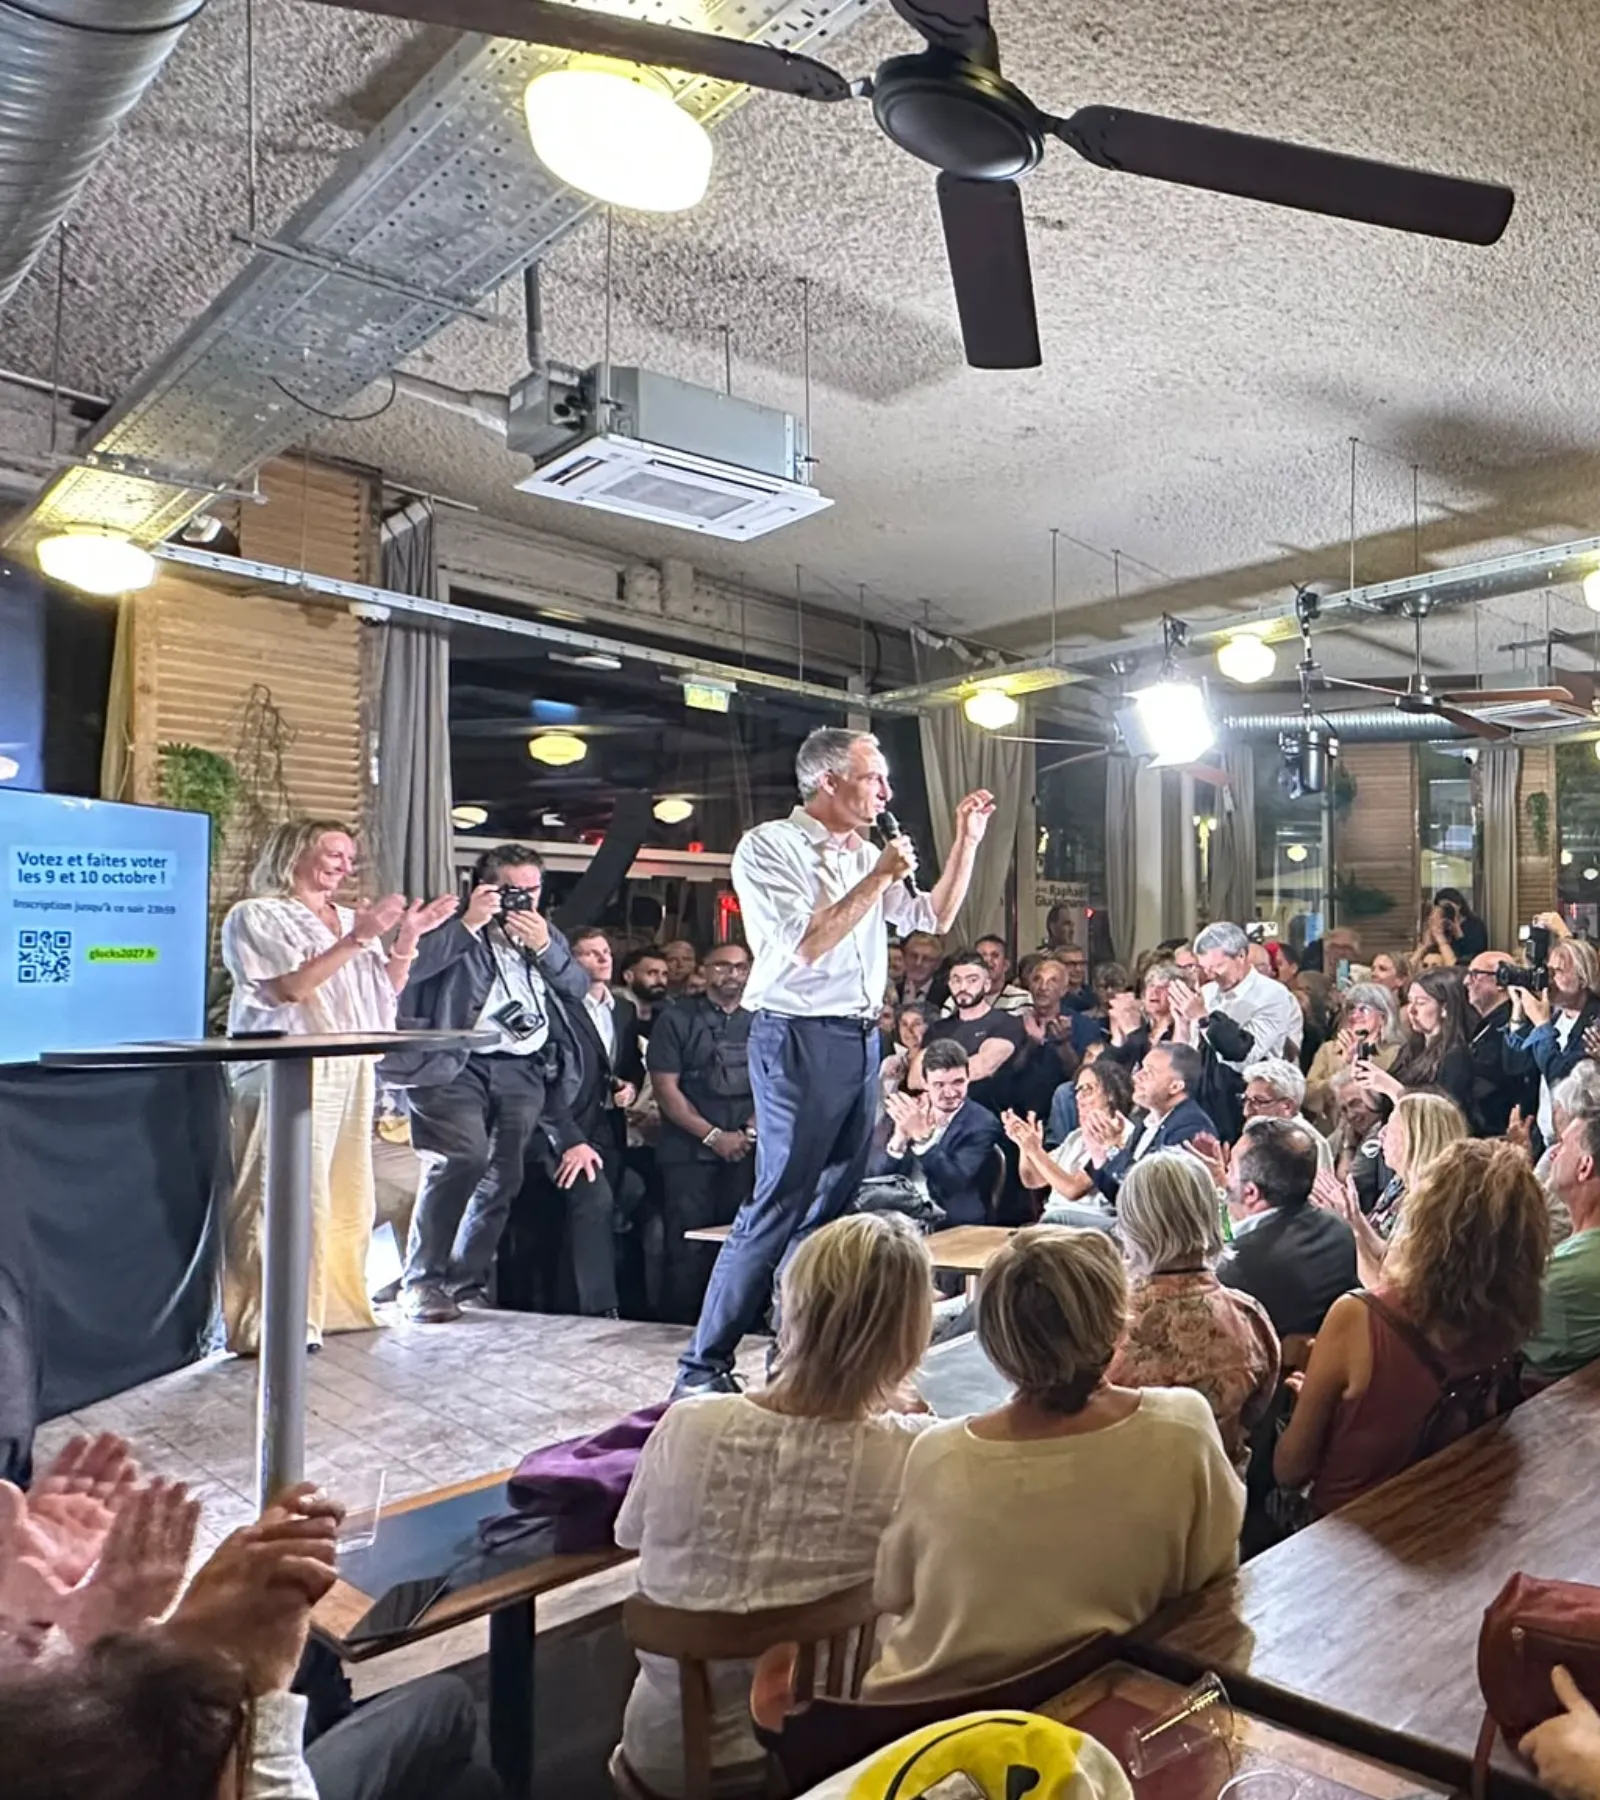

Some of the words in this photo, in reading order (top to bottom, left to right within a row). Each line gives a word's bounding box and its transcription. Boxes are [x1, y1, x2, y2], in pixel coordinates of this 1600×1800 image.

[17, 851, 63, 867] Votez
[67, 854, 83, 867] et
[87, 852, 128, 868] faites
[130, 856, 168, 869] voter
[18, 868, 42, 884] les
[45, 869, 55, 884] 9
[59, 871, 76, 884] et
[80, 869, 99, 884] 10
[101, 870, 157, 885] octobre
[12, 899, 73, 912] Inscription
